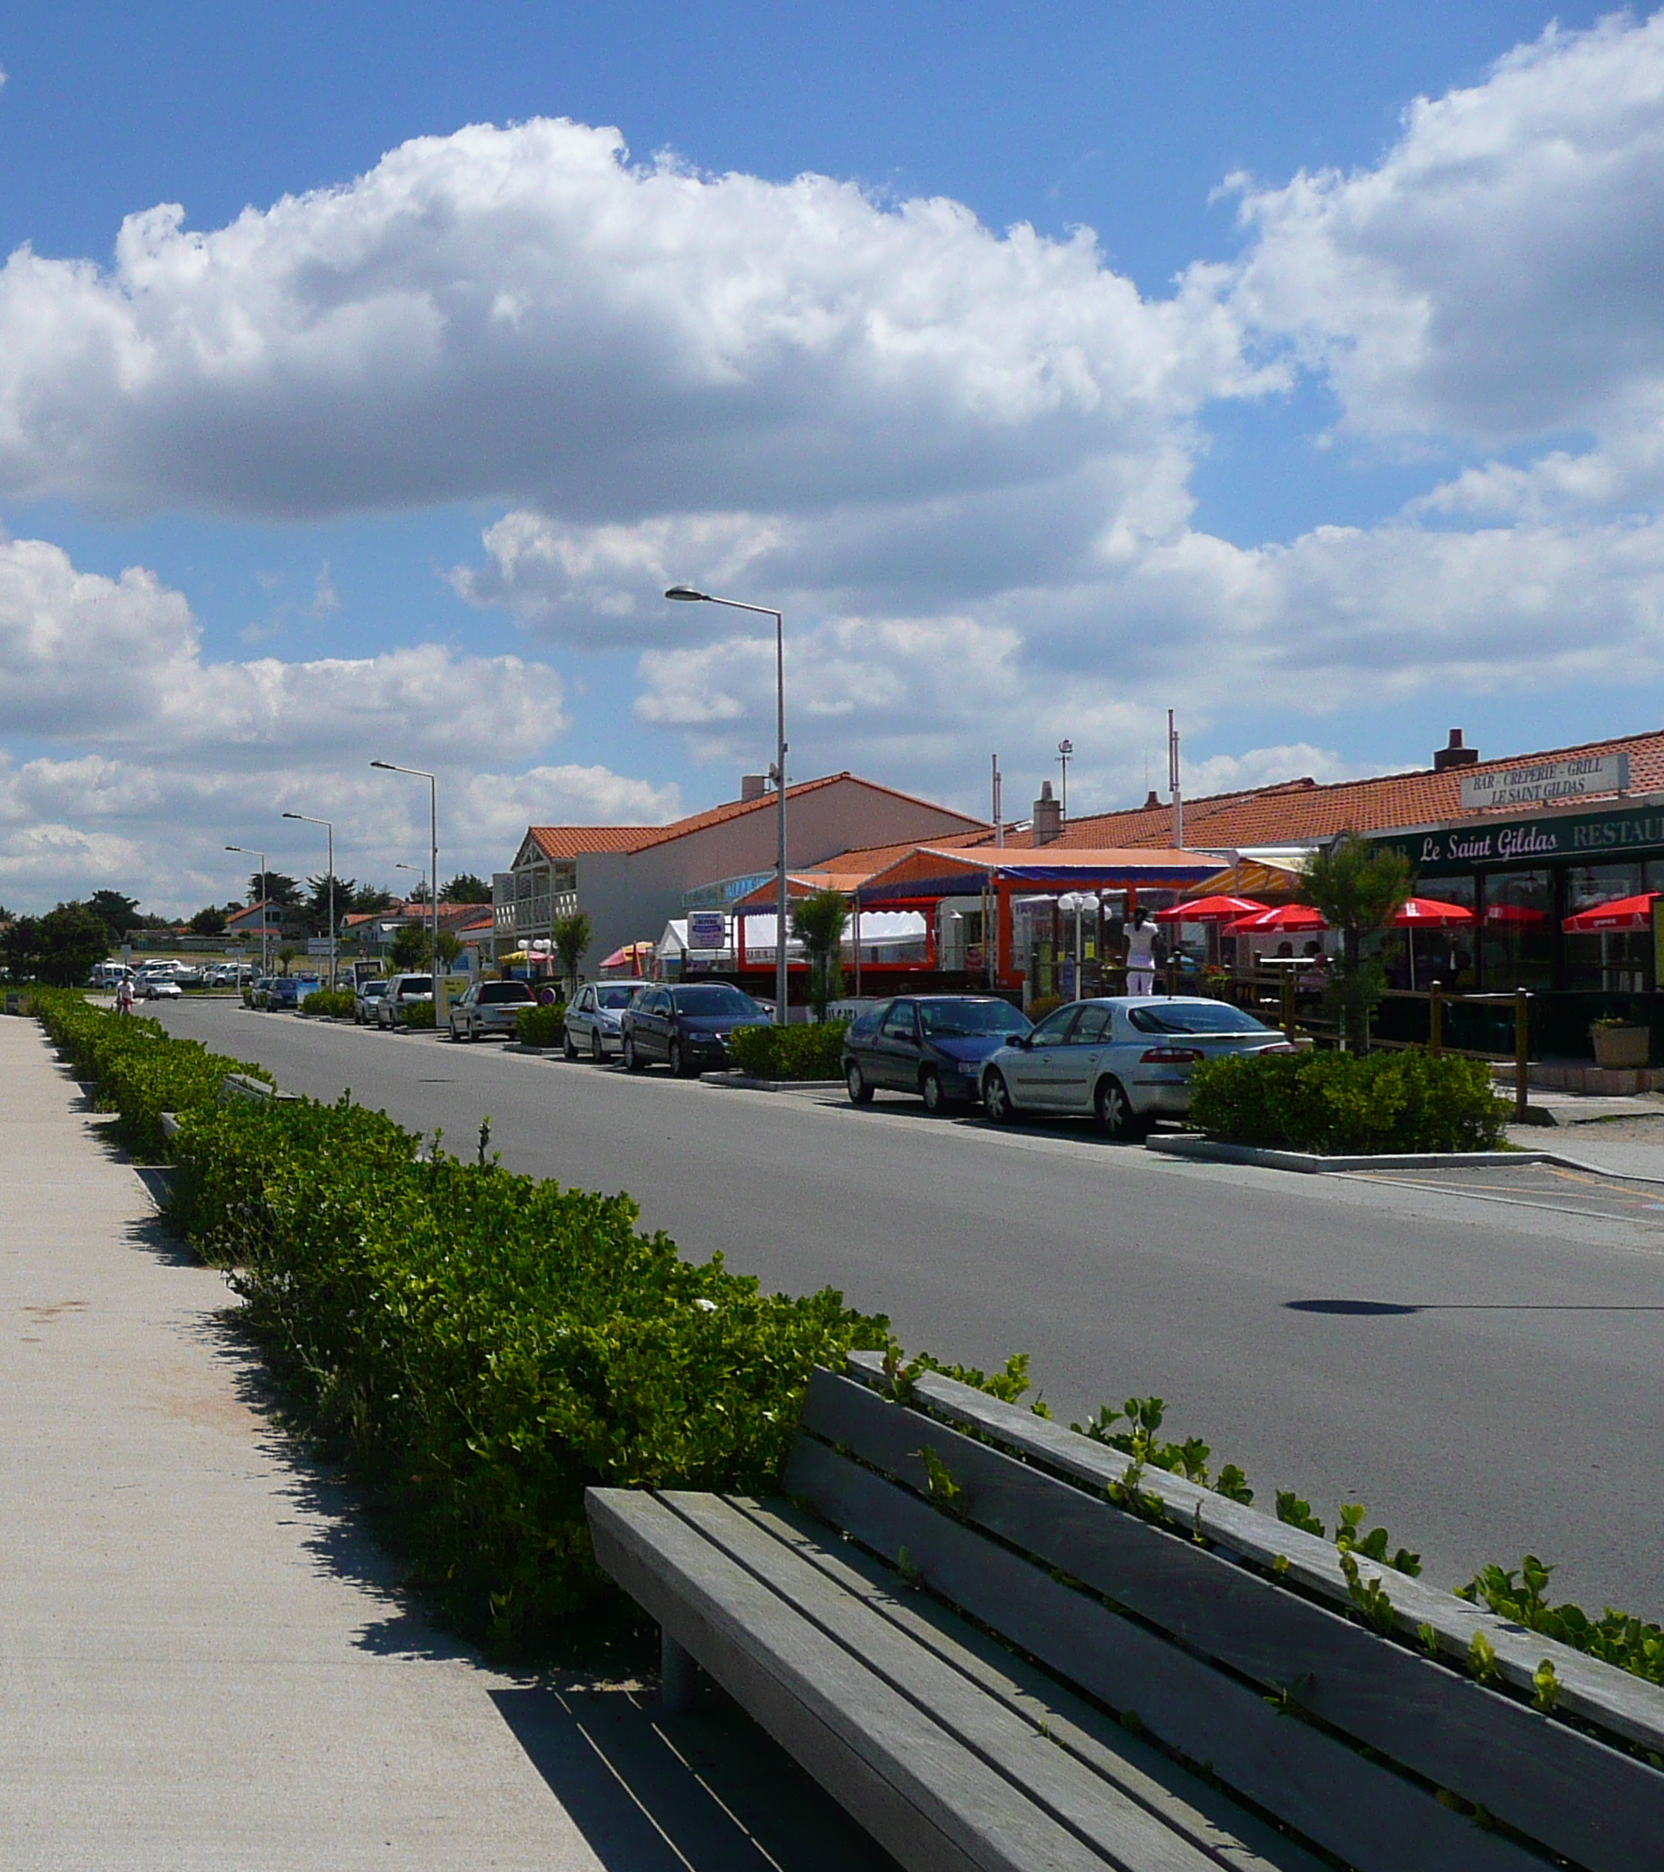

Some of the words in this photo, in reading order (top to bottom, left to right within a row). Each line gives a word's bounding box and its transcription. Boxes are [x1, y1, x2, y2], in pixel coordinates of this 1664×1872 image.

[1473, 775, 1495, 791] BAR
[1504, 765, 1557, 786] CREPERIE
[1568, 758, 1603, 777] GRILL
[1491, 790, 1507, 804] LE
[1509, 784, 1542, 803] SAINT
[1544, 778, 1586, 797] GILDAS
[1420, 837, 1441, 862] Le
[1447, 834, 1491, 860] Saint
[1498, 826, 1558, 862] Gildas
